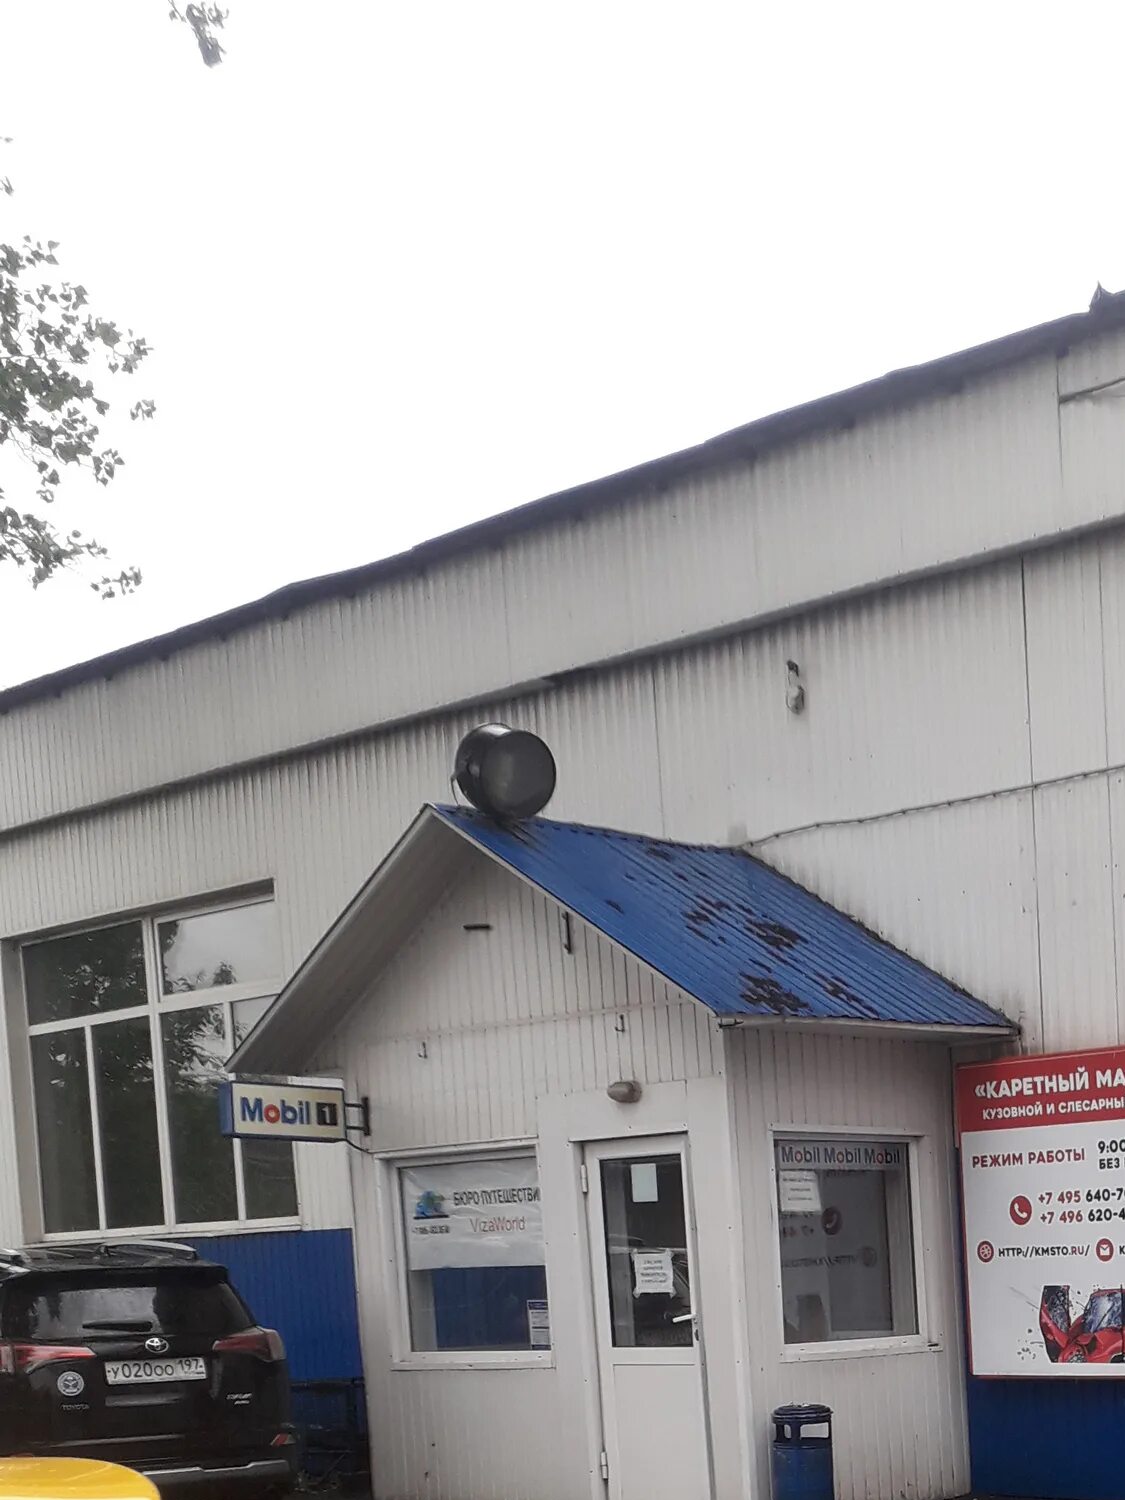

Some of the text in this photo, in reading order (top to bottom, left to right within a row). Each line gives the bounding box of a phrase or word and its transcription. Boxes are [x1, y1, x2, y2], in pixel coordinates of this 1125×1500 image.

[974, 1066, 1090, 1099] «КАРЕТНЫЙ
[241, 1096, 336, 1126] Mobil 1
[982, 1102, 1043, 1120] КУЗОВНОЙ
[1046, 1105, 1056, 1114] И
[781, 1146, 900, 1165] Mobil Mobil Mobil
[972, 1148, 1086, 1169] РЕЖИМ РАБОТЫ
[1098, 1157, 1121, 1170] БЕЗ
[1038, 1192, 1053, 1205] +7
[1057, 1190, 1081, 1204] 495
[1040, 1211, 1055, 1224] +7
[1059, 1209, 1083, 1223] 496
